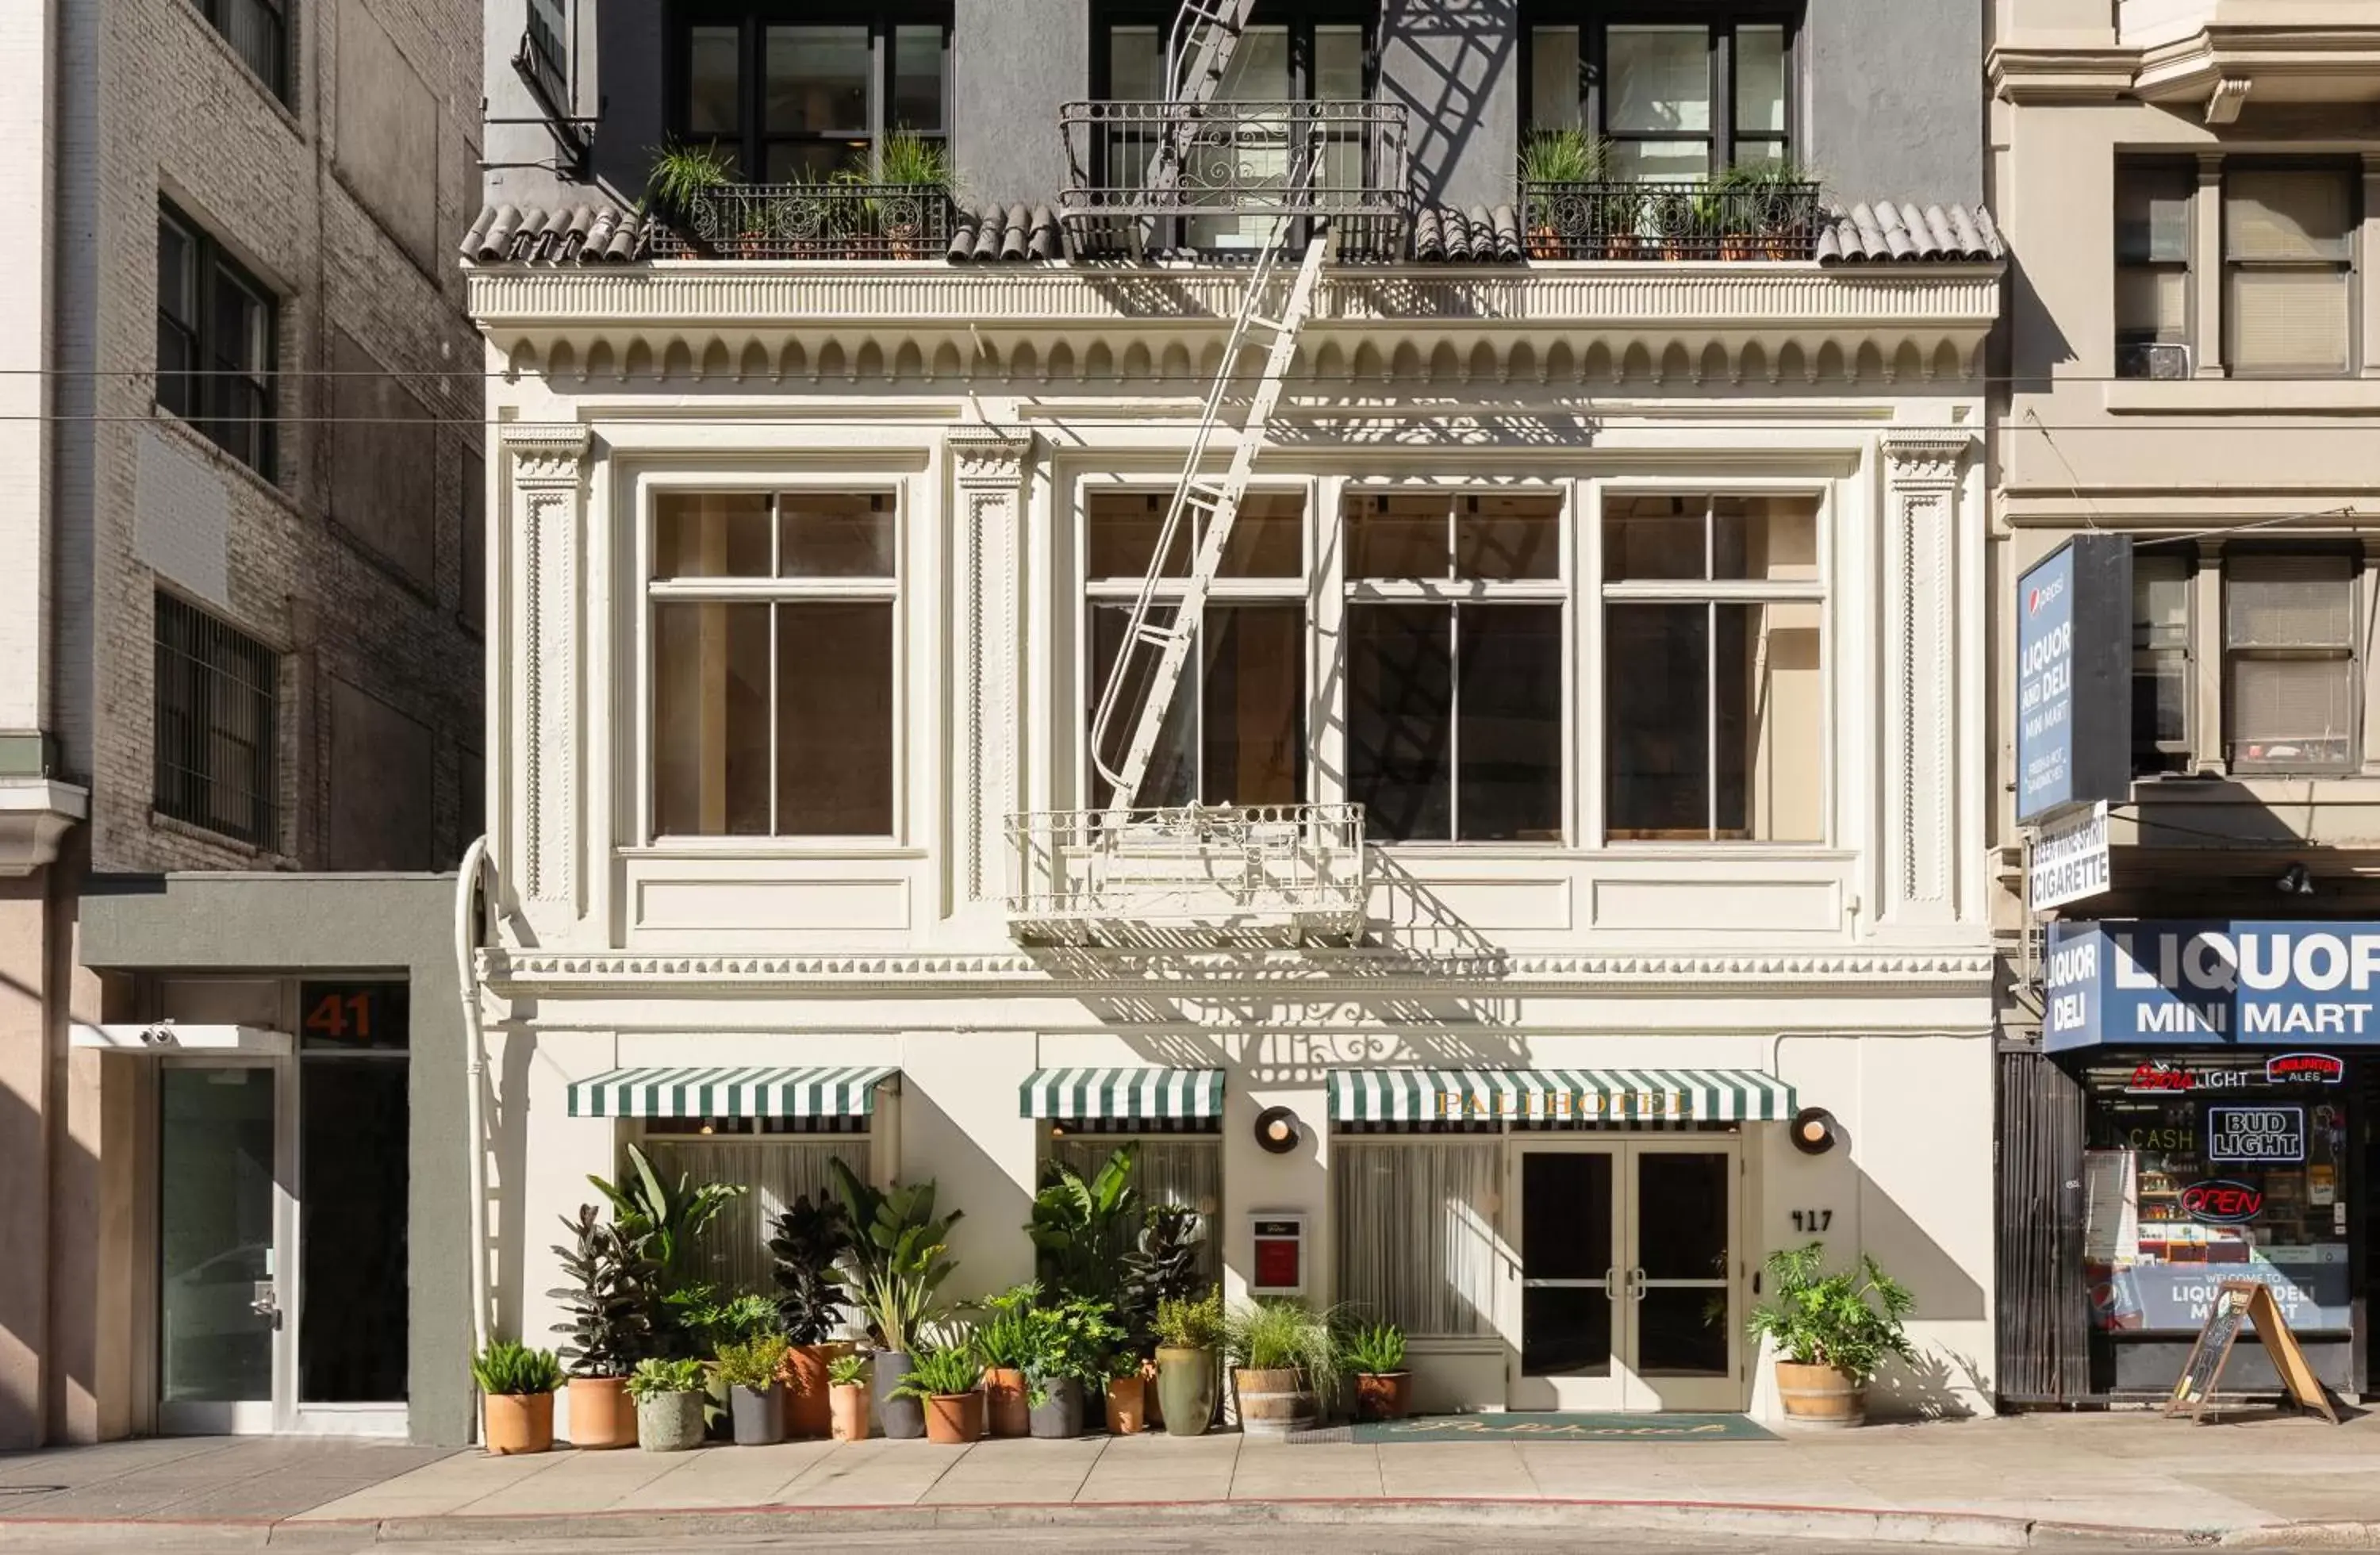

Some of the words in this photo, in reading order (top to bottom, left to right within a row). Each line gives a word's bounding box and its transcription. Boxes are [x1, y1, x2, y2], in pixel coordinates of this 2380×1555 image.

[2023, 620, 2071, 678] LIQUOR
[2022, 683, 2041, 711] AND
[2043, 658, 2070, 702] DELI
[2033, 851, 2108, 903] CIGARETTE
[2054, 991, 2086, 1032] DELI
[2136, 1002, 2227, 1033] MINI
[2244, 1002, 2373, 1034] MART
[2132, 1061, 2195, 1089] Coors
[2194, 1071, 2249, 1088] LIGHT
[2288, 1072, 2321, 1082] ALES
[1435, 1091, 1693, 1115] PALIHOTEL
[2225, 1112, 2287, 1134] BUD
[2129, 1128, 2194, 1150] CASH
[2182, 1186, 2261, 1215] OPEN
[1792, 1209, 1833, 1232] 417
[2264, 1273, 2282, 1284] TO
